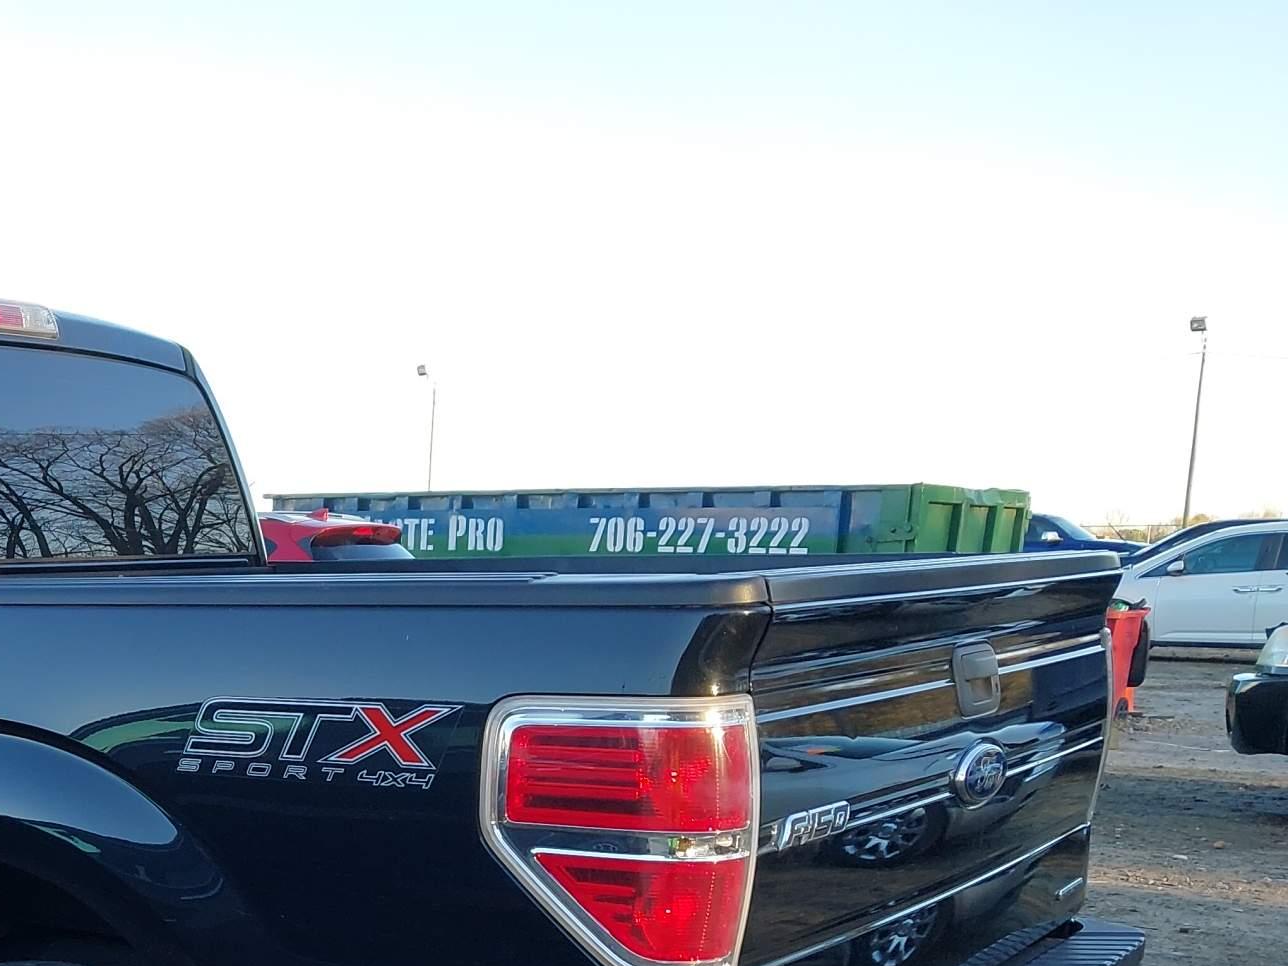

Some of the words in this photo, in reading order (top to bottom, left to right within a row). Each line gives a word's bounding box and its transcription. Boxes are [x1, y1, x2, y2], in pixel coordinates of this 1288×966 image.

[448, 514, 504, 551] PRO
[589, 517, 810, 555] 706-227-3222
[183, 696, 463, 769] STX
[177, 758, 344, 782] SPORT
